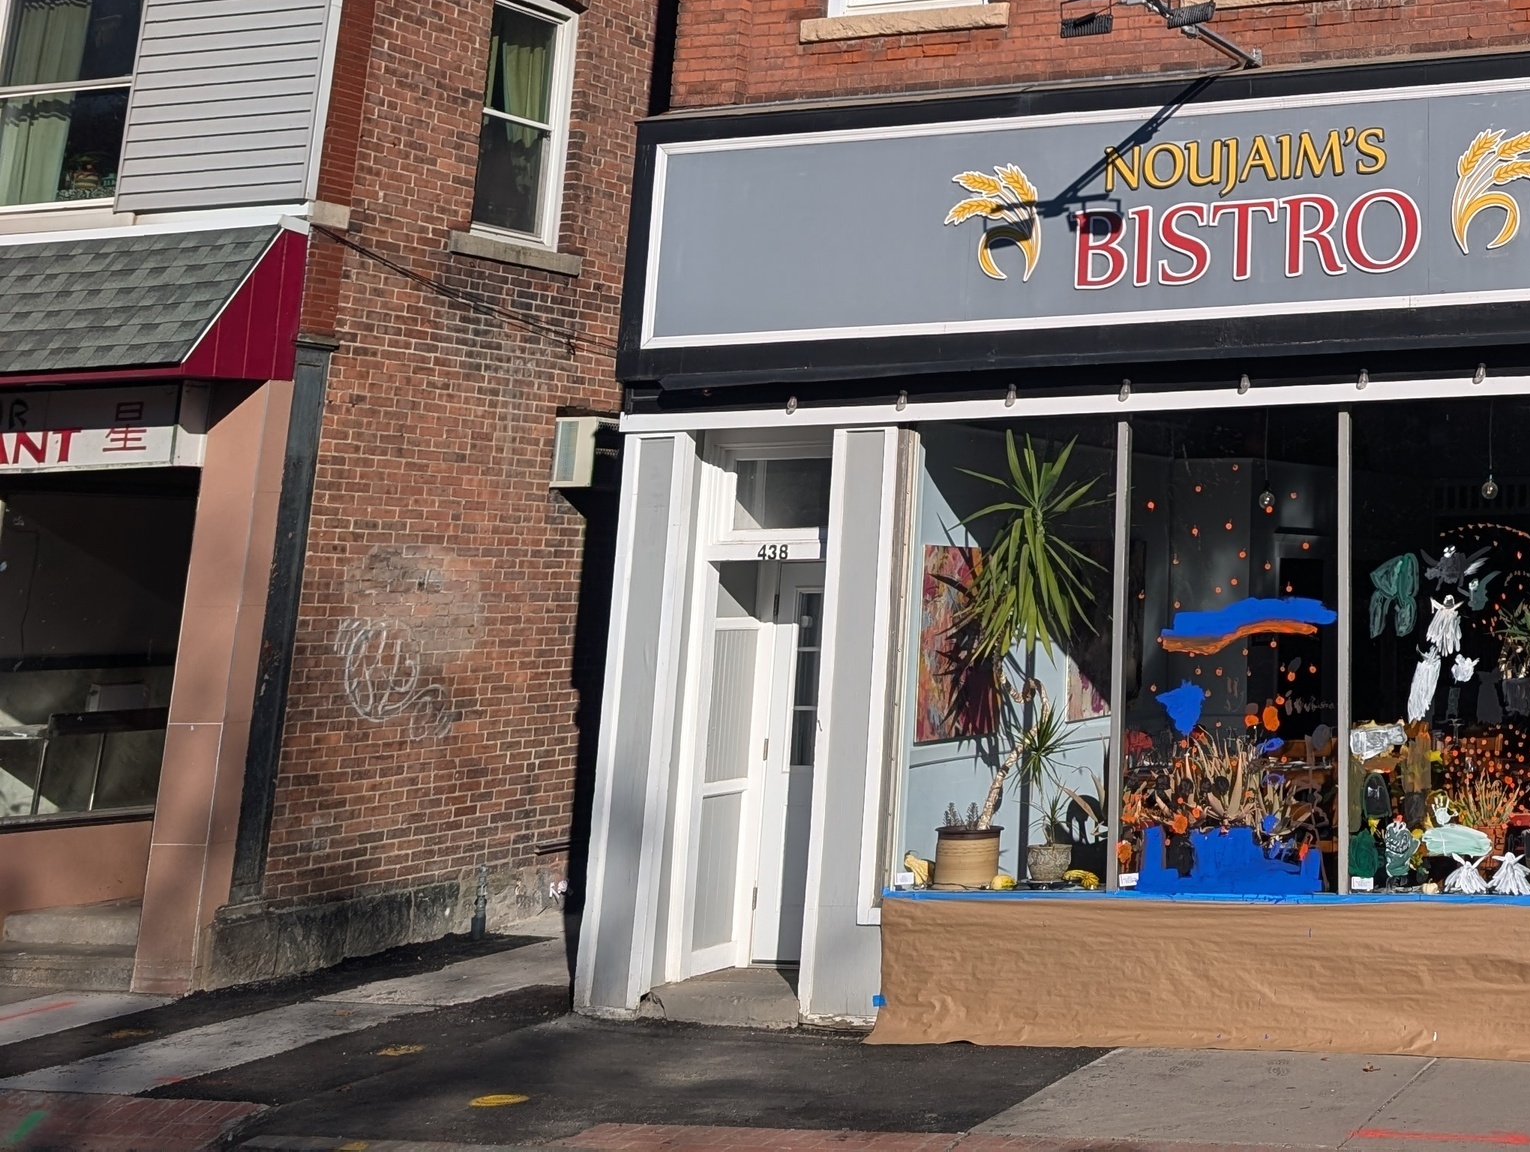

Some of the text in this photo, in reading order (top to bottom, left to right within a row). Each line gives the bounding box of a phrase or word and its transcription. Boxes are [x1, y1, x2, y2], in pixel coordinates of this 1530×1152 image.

[1105, 127, 1387, 196] NOUJAIM'S
[1074, 188, 1421, 289] BISTRO
[757, 544, 788, 560] 438
